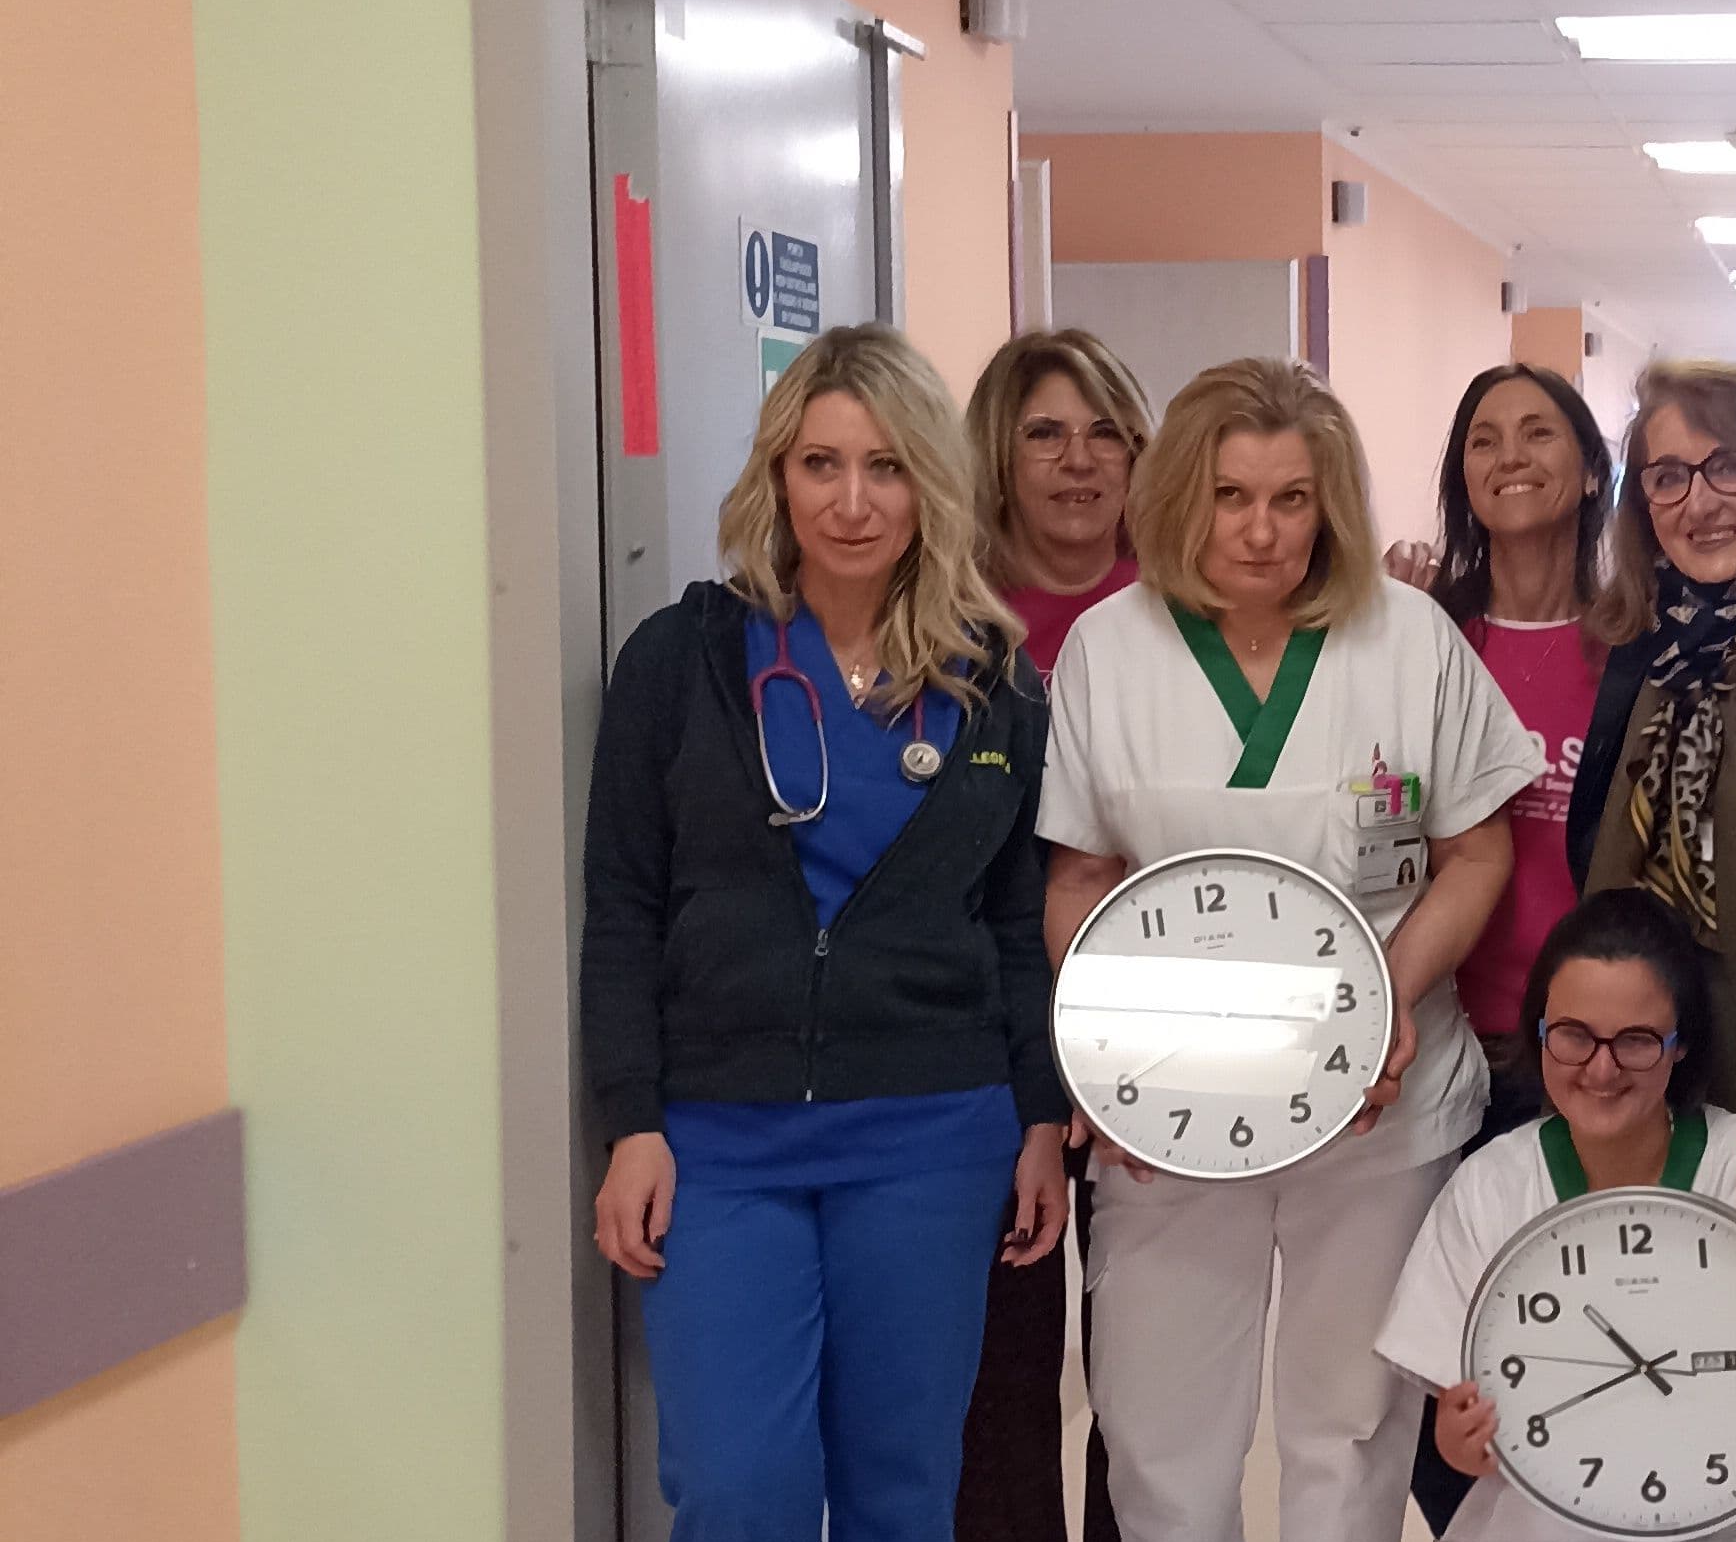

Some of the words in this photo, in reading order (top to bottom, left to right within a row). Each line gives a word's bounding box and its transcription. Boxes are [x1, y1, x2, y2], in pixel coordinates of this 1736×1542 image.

[1195, 884, 1226, 913] 12
[1269, 892, 1278, 919] 1
[1142, 909, 1165, 938] 11
[1316, 928, 1336, 956] 2
[1336, 983, 1356, 1012] 3
[1324, 1045, 1350, 1074] 4
[1290, 1092, 1311, 1123] 5
[1169, 1109, 1192, 1139] 7
[1230, 1116, 1253, 1147] 6
[1619, 1223, 1653, 1255] 12
[1698, 1238, 1707, 1268] 1
[1561, 1244, 1586, 1276] 11
[1518, 1292, 1560, 1324] 10
[1501, 1356, 1525, 1389] 9
[1526, 1415, 1551, 1448] 8
[1580, 1458, 1603, 1488] 7
[1706, 1453, 1728, 1485] 5
[1641, 1471, 1666, 1503] 6
